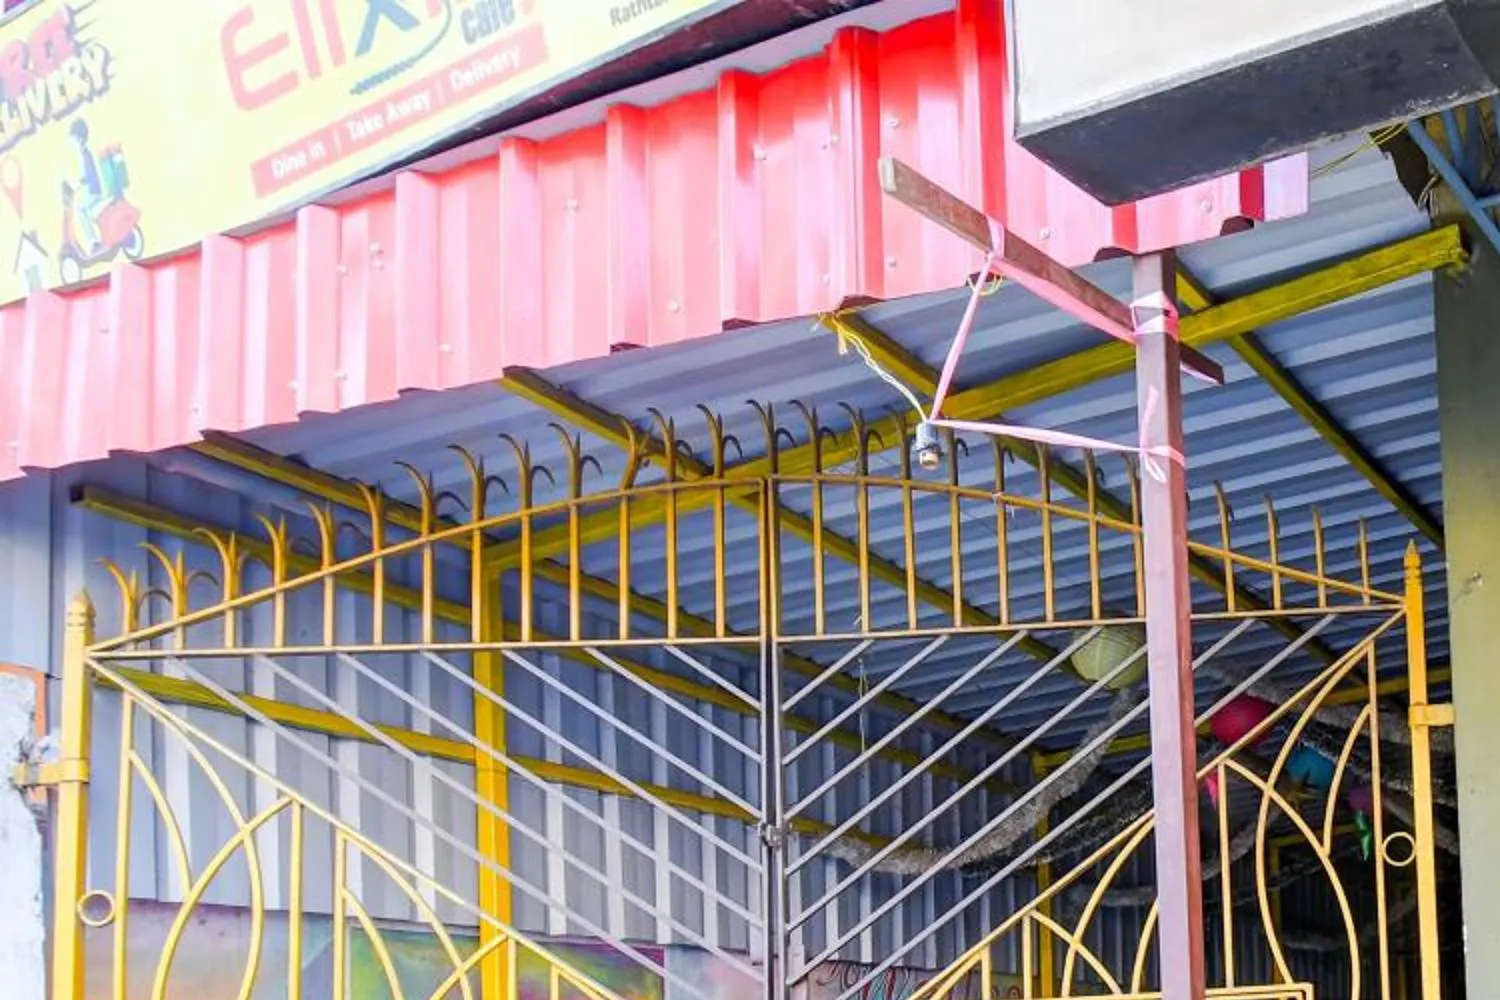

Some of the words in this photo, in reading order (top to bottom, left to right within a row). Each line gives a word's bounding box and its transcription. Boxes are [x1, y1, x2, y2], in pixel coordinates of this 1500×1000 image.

[346, 112, 385, 141] Take
[386, 89, 431, 126] Away
[451, 47, 520, 92] Delivery
